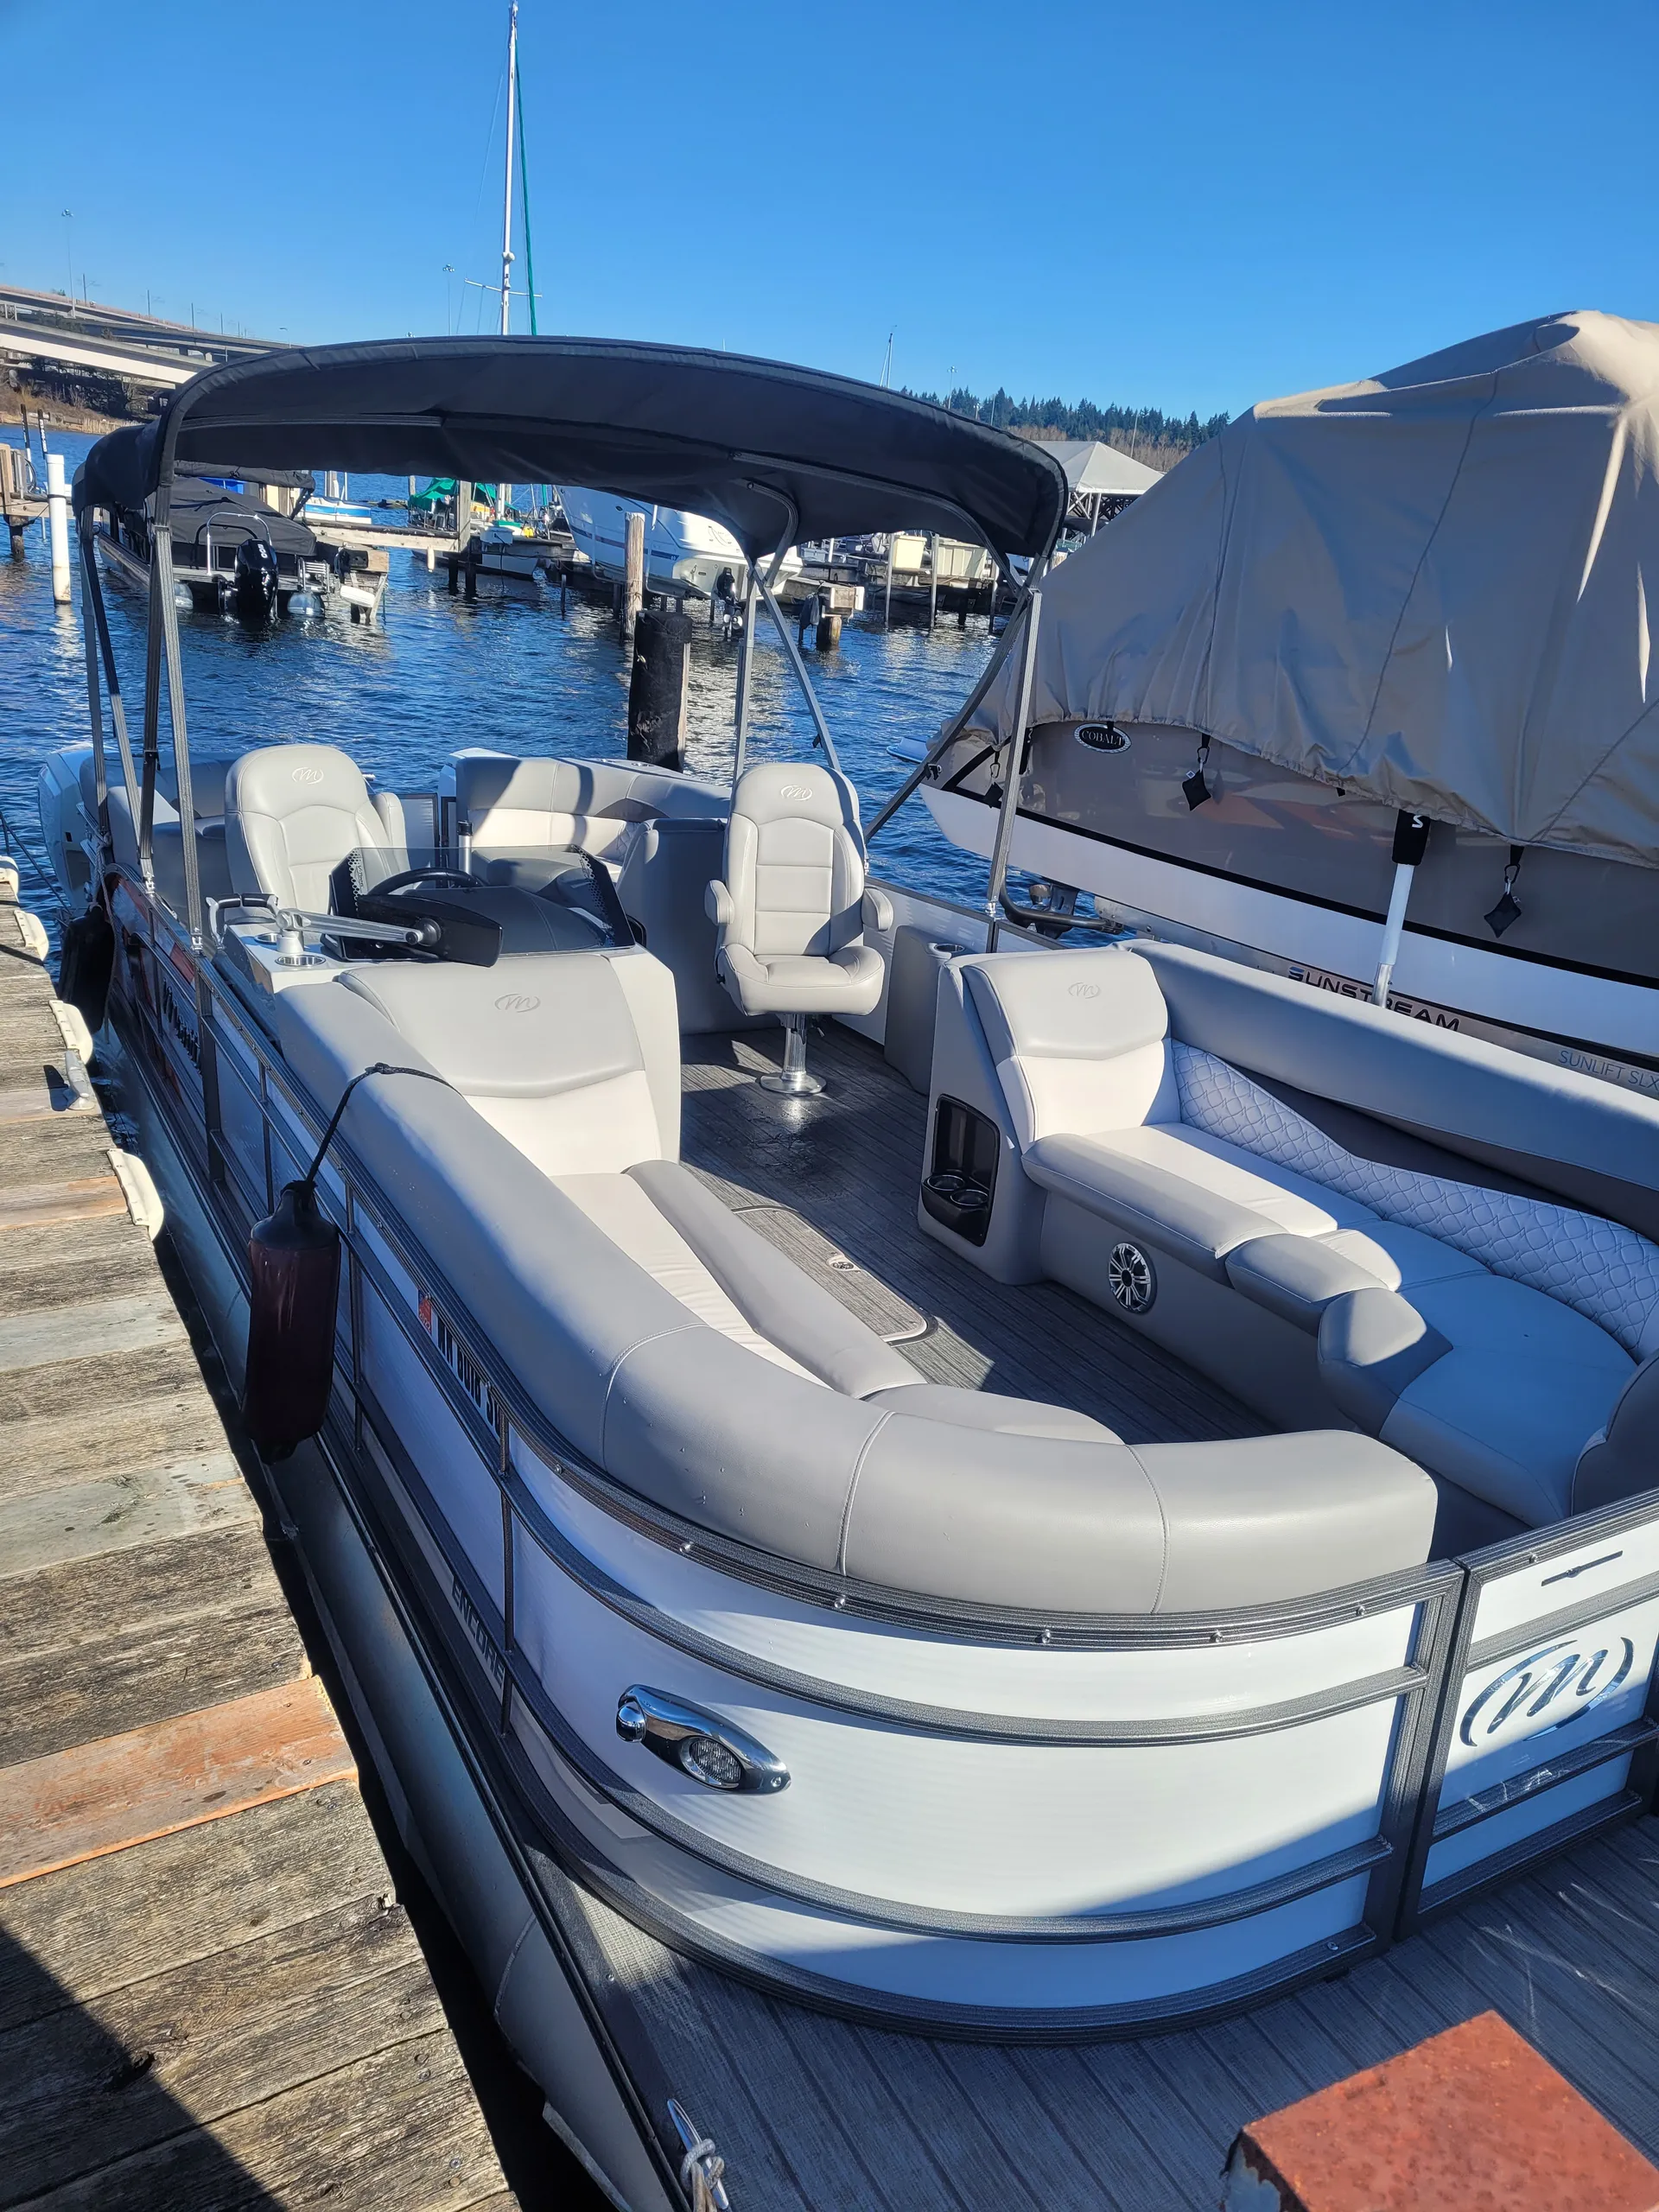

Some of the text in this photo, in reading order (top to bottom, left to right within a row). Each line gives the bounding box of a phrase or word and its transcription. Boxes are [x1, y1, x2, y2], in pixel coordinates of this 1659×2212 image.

[1081, 730, 1124, 747] COBALT
[1559, 1050, 1659, 1091] SUNLIFT SLX
[451, 1580, 505, 1688] ENCORE
